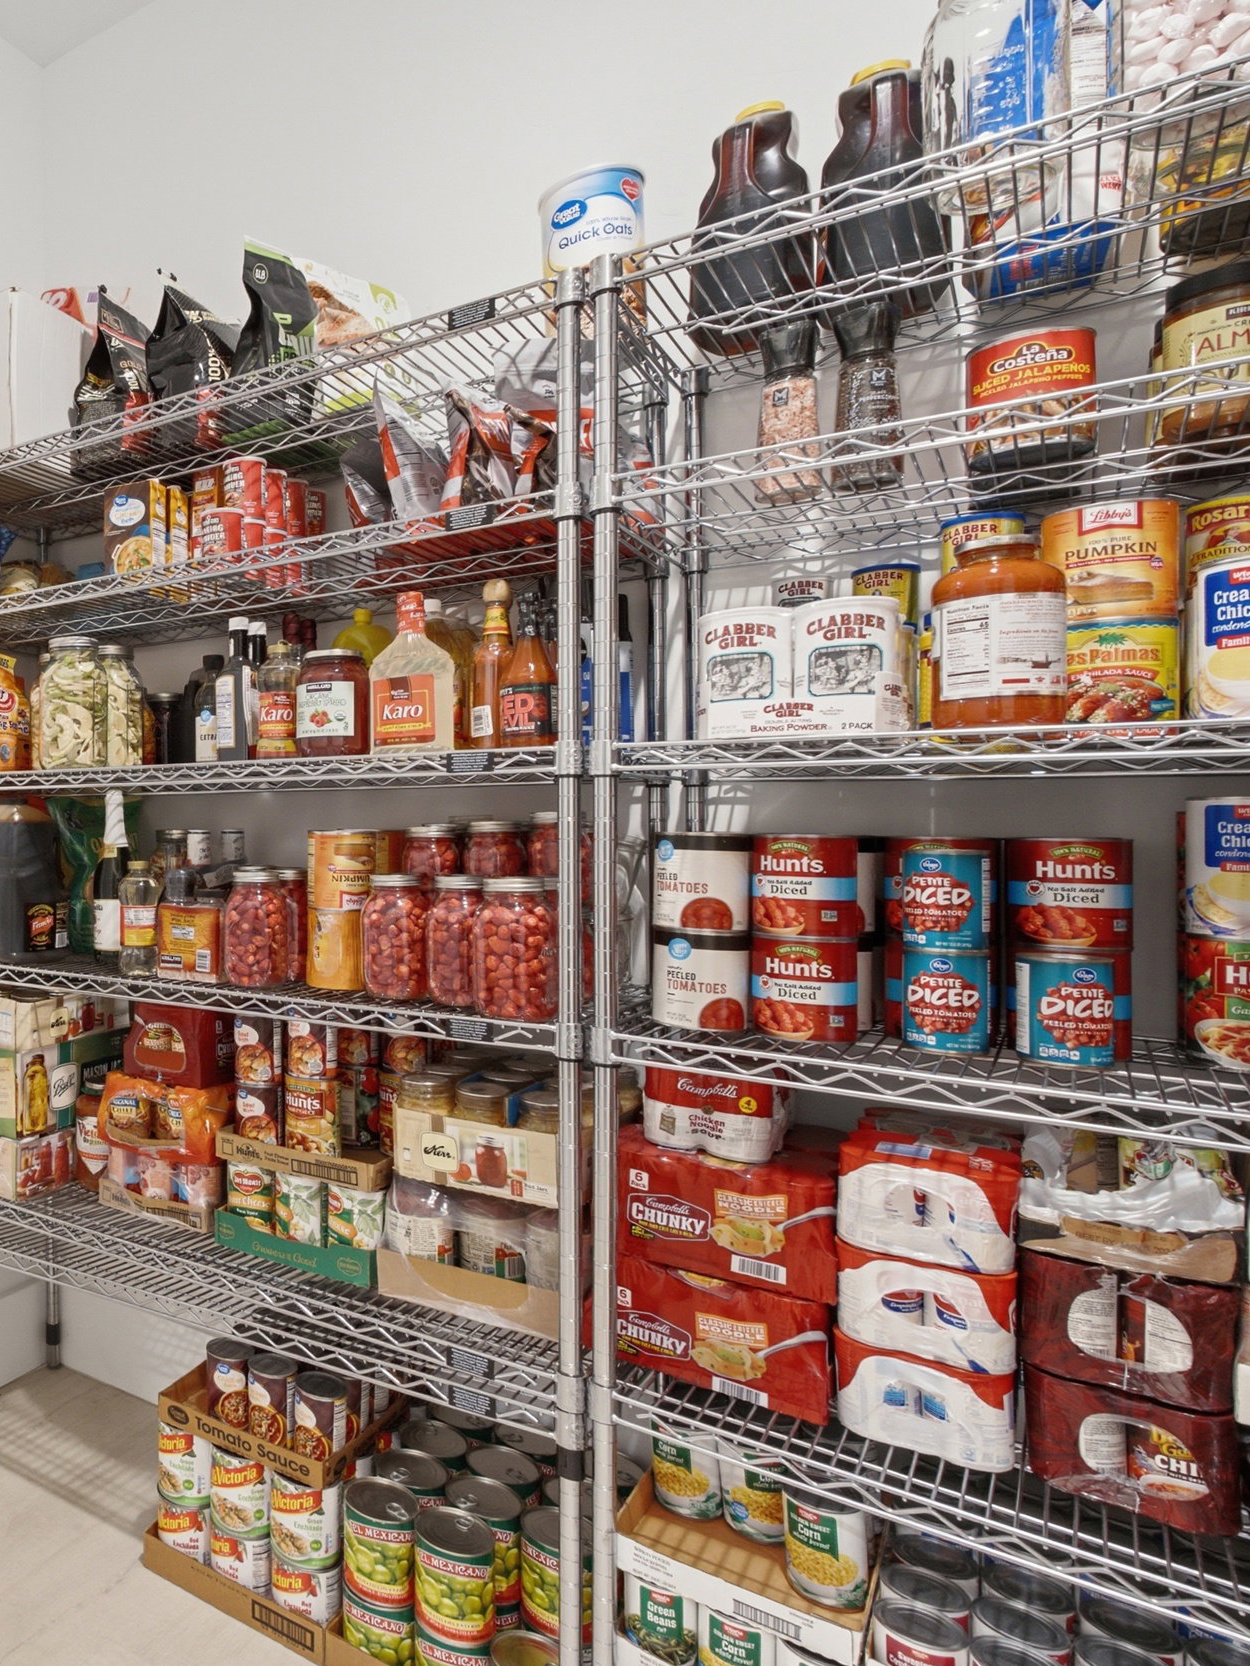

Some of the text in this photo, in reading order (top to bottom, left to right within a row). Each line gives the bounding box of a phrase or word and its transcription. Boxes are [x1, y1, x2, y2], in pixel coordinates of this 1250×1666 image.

[554, 203, 580, 222] Great
[559, 223, 633, 250] Quick Oats
[1022, 344, 1040, 355] La
[993, 348, 1069, 373] Costeña
[973, 362, 1090, 396] SLICED JALAPEÑOS
[1088, 508, 1132, 525] Libby's
[943, 522, 999, 544] CLABBER
[1088, 534, 1133, 546] 100% PURE
[1064, 541, 1158, 562] PUMPKIN
[855, 570, 904, 587] CLABBER
[863, 579, 890, 590] GIRL
[777, 580, 824, 595] CLABBER
[787, 587, 813, 597] GIRL
[806, 613, 886, 637] CLABBER
[704, 622, 778, 646] CLABBER
[718, 633, 758, 650] GIRL
[822, 626, 867, 642] GIRL
[1089, 647, 1160, 663] Palmas
[1124, 667, 1154, 679] SAUCE
[260, 706, 293, 722] Karo
[382, 703, 423, 721] Karo
[763, 702, 814, 715] CLABBER
[775, 708, 802, 718] GIRL
[750, 722, 828, 734] BAKING POWDER
[841, 721, 874, 731] 2 PACK
[759, 854, 828, 874] Hunt's
[1035, 860, 1117, 880] Hunt's
[656, 872, 678, 882] PEELED
[911, 875, 951, 887] PETITE
[656, 880, 709, 895] TOMATOES
[770, 884, 808, 896] Diced
[1047, 886, 1106, 895] No Salt Added
[903, 886, 972, 906] DICED
[1052, 891, 1100, 904] Diced
[923, 909, 968, 917] TOMATOES
[666, 970, 697, 982] PEELED
[765, 957, 835, 980] Hunt's
[666, 977, 728, 995] TOMATOES
[920, 975, 962, 989] PETITE
[777, 987, 818, 1001] Diced
[907, 985, 980, 1007] DICED
[1060, 986, 1105, 999] PETITE
[933, 1009, 977, 1019] TOMATOES
[1040, 997, 1114, 1019] DICED
[83, 1065, 108, 1081] MASON
[53, 1075, 76, 1098] Ball
[677, 1077, 738, 1099] Campbell's
[285, 1092, 320, 1110] Hunt's
[688, 1114, 726, 1127] Chicken
[688, 1120, 724, 1133] Noodle
[690, 1128, 722, 1140] SOUP
[423, 1145, 452, 1159] Kerr
[634, 1172, 643, 1182] 6
[645, 1197, 690, 1215] Campbell's
[718, 1201, 786, 1213] NOODLE
[631, 1202, 706, 1235] CHUNKY
[1075, 1231, 1100, 1242] BEST
[619, 1289, 627, 1299] 6
[628, 1313, 671, 1335] Campbell's
[699, 1323, 766, 1341] NOODLE
[617, 1319, 687, 1354] CHUNKY
[195, 1415, 310, 1477] Tomato Sauce
[351, 1524, 364, 1536] EL
[797, 1524, 822, 1542] Corn
[809, 1524, 831, 1533] SWEET
[418, 1551, 488, 1580] EL MEXICANO
[647, 1601, 676, 1618] Green
[352, 1605, 405, 1634] MEXICANO
[646, 1612, 677, 1629] Beans
[420, 1641, 432, 1655] EL
[721, 1640, 746, 1659] Corn
[735, 1639, 755, 1650] SWEET
